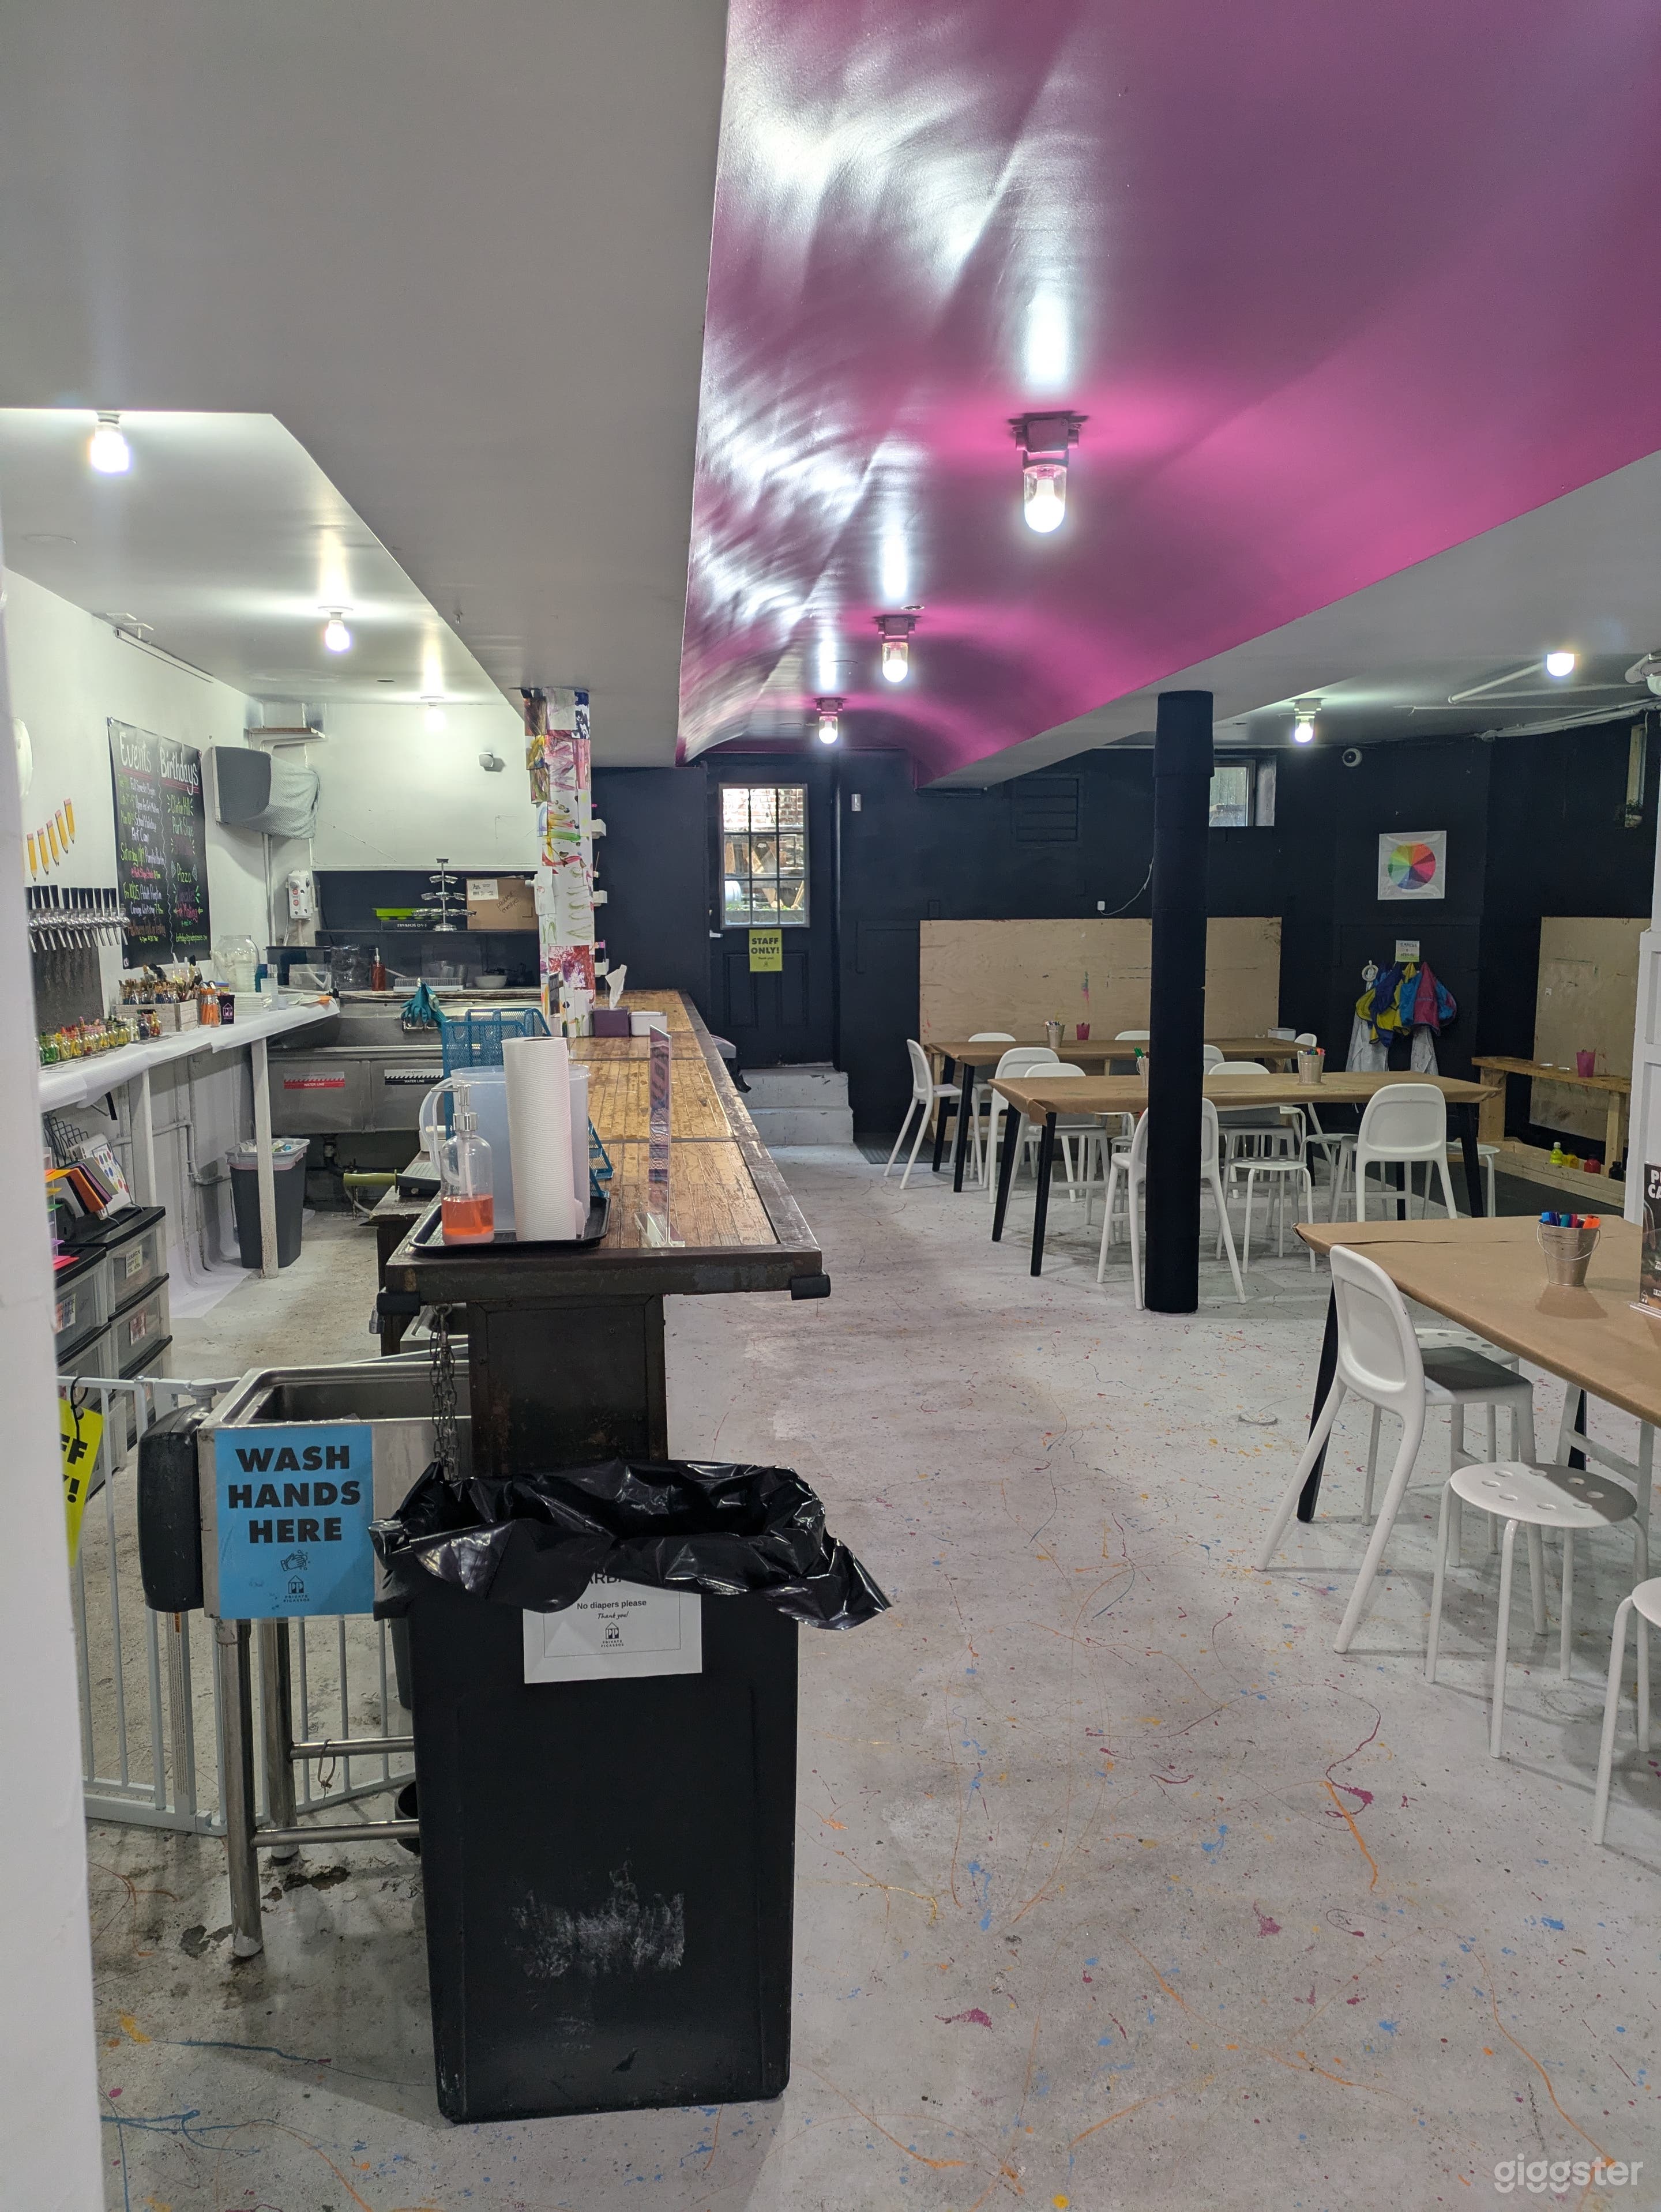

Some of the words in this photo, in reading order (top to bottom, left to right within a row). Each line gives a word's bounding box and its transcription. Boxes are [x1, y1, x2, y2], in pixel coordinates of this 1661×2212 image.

[119, 732, 151, 773] Events
[160, 746, 199, 796] Birthdays
[176, 862, 191, 883] Pizza
[235, 1446, 350, 1473] WASH
[228, 1481, 361, 1509] HANDS
[249, 1517, 342, 1544] HERE
[590, 1602, 619, 1610] diapers
[621, 1600, 647, 1609] please
[616, 1611, 629, 1620] you!
